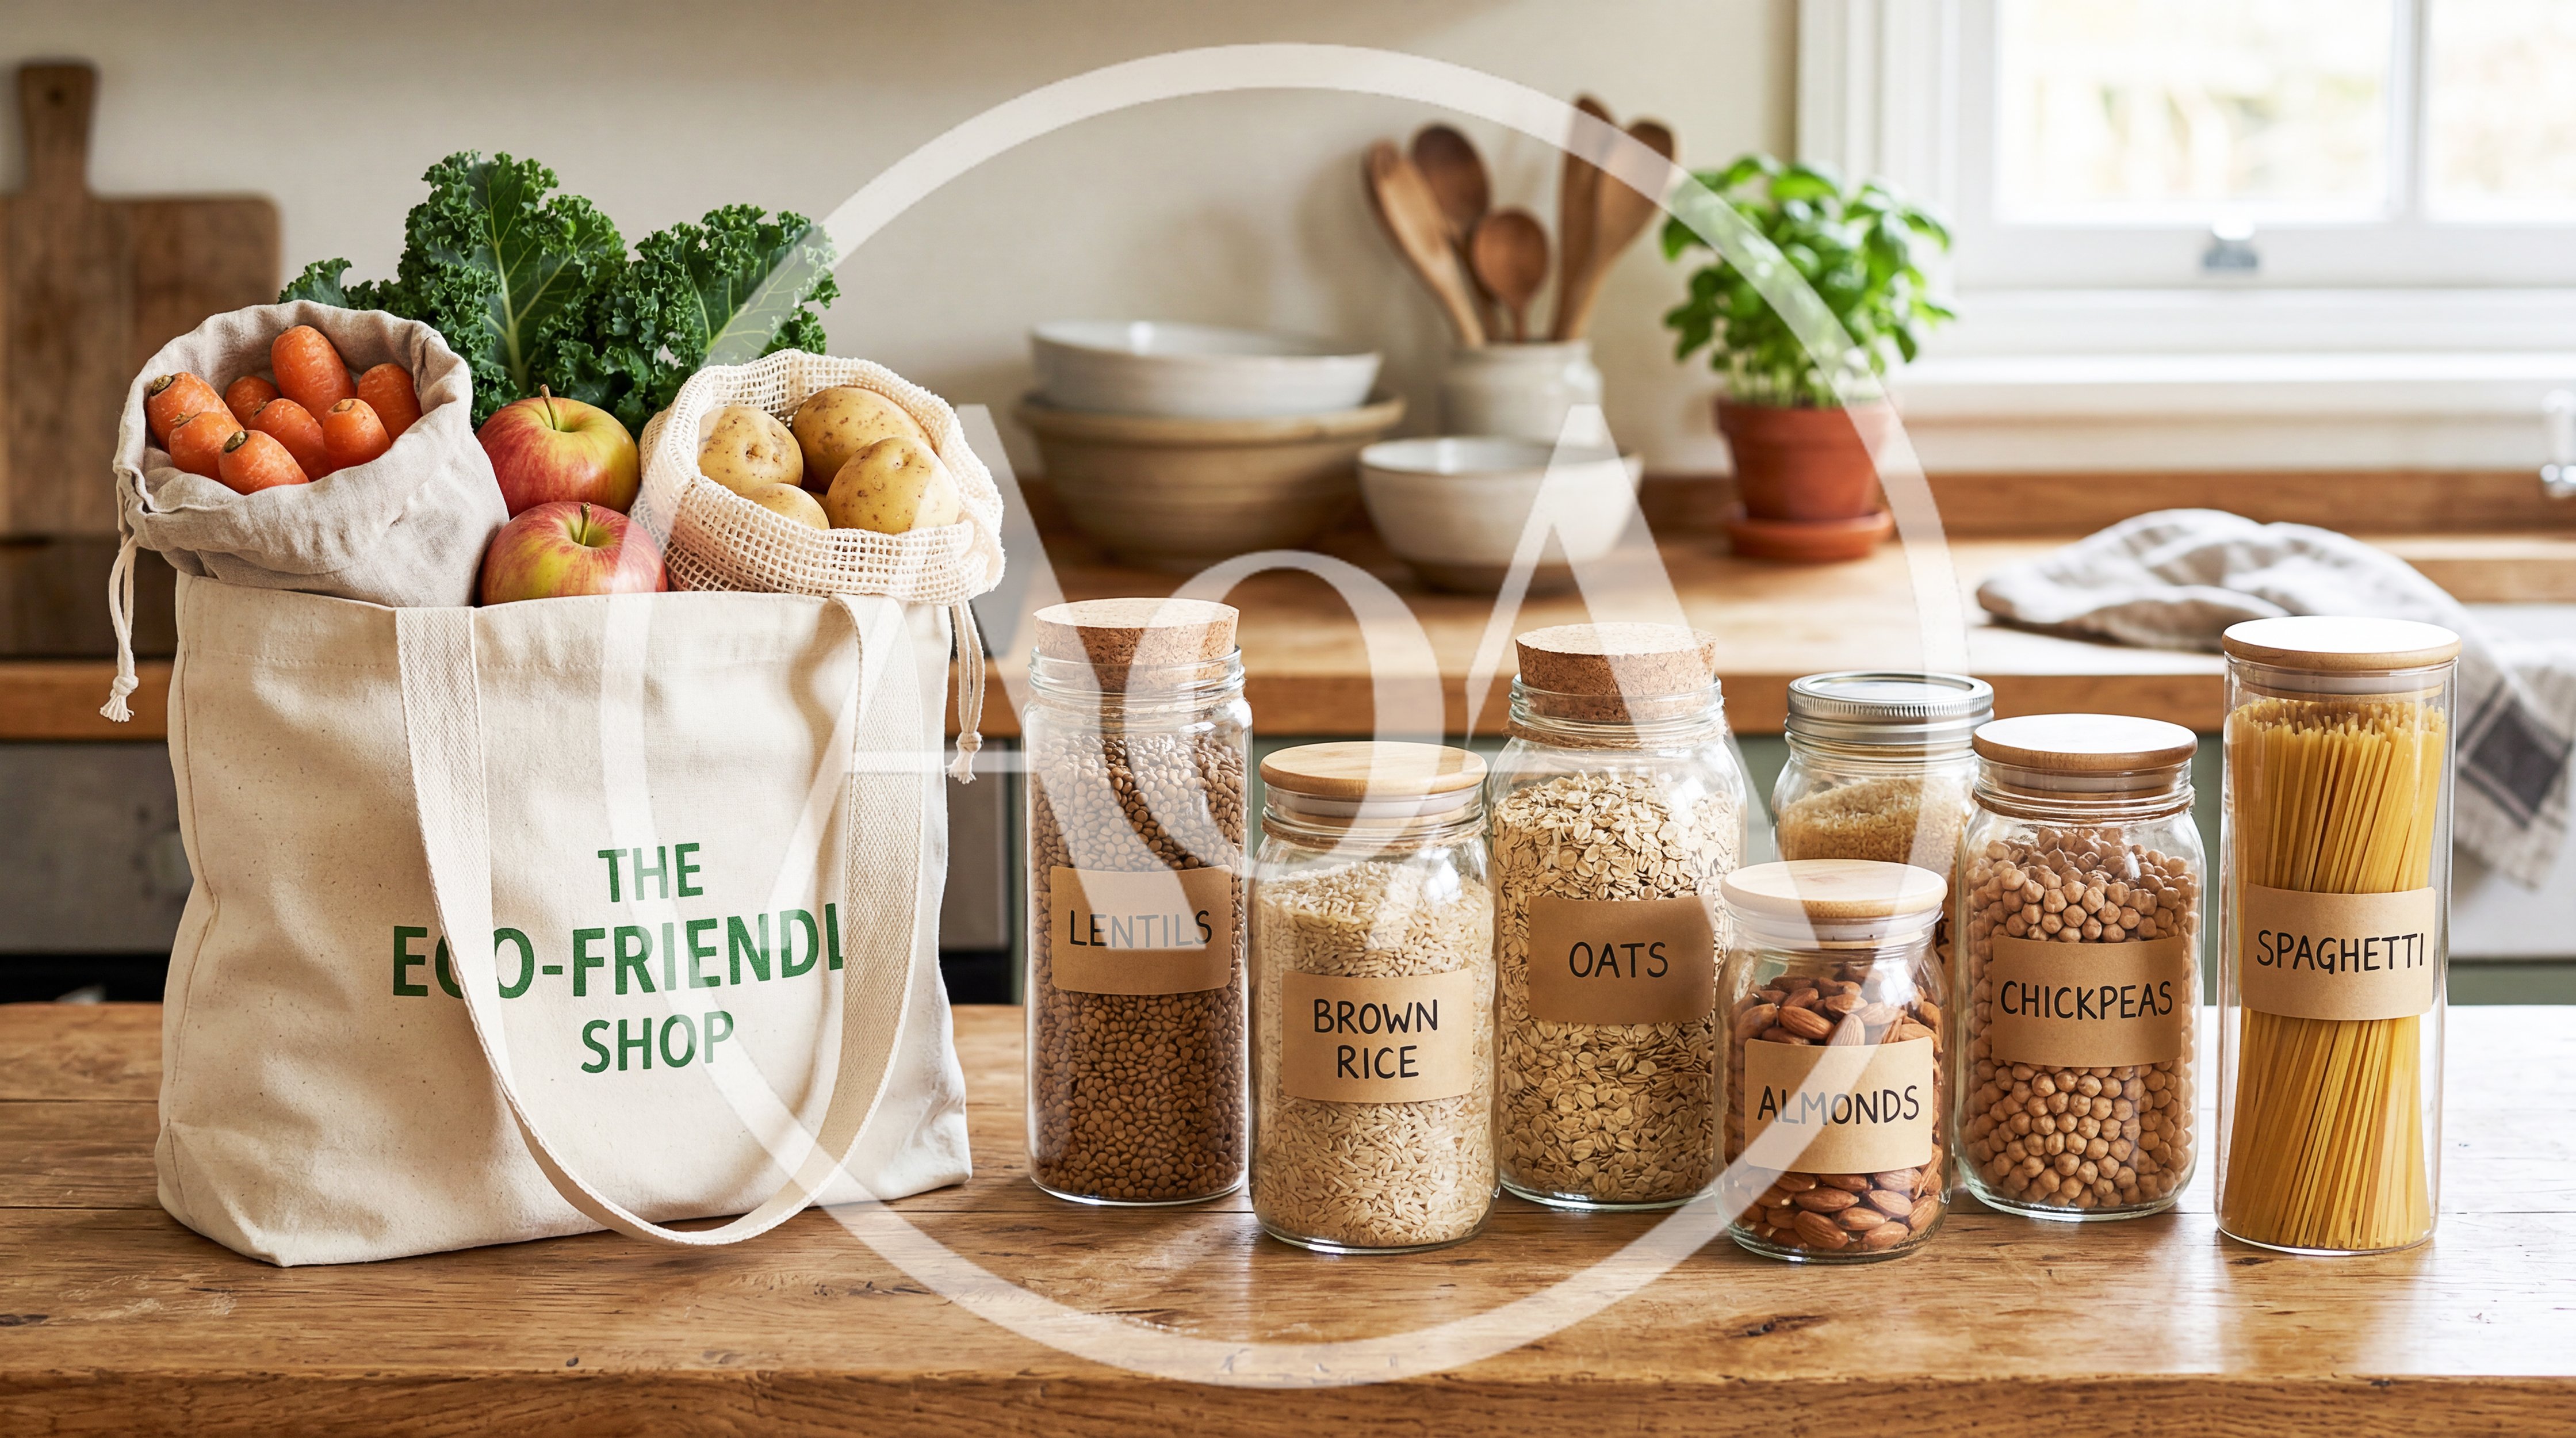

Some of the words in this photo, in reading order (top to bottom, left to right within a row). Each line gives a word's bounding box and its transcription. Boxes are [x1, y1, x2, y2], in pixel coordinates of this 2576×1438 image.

[598, 843, 703, 902] THE
[1070, 910, 1212, 949] LENTILS
[393, 903, 843, 999] ECO-FRIENDL
[1568, 942, 1669, 978] OATS
[2256, 929, 2424, 975] SPAGHETTI
[1314, 998, 1438, 1035] BROWN
[2000, 981, 2173, 1020] CHICKPEAS
[581, 1011, 734, 1073] SHOP
[1337, 1044, 1419, 1079] RICE
[1757, 1085, 1920, 1125] ALMONDS
